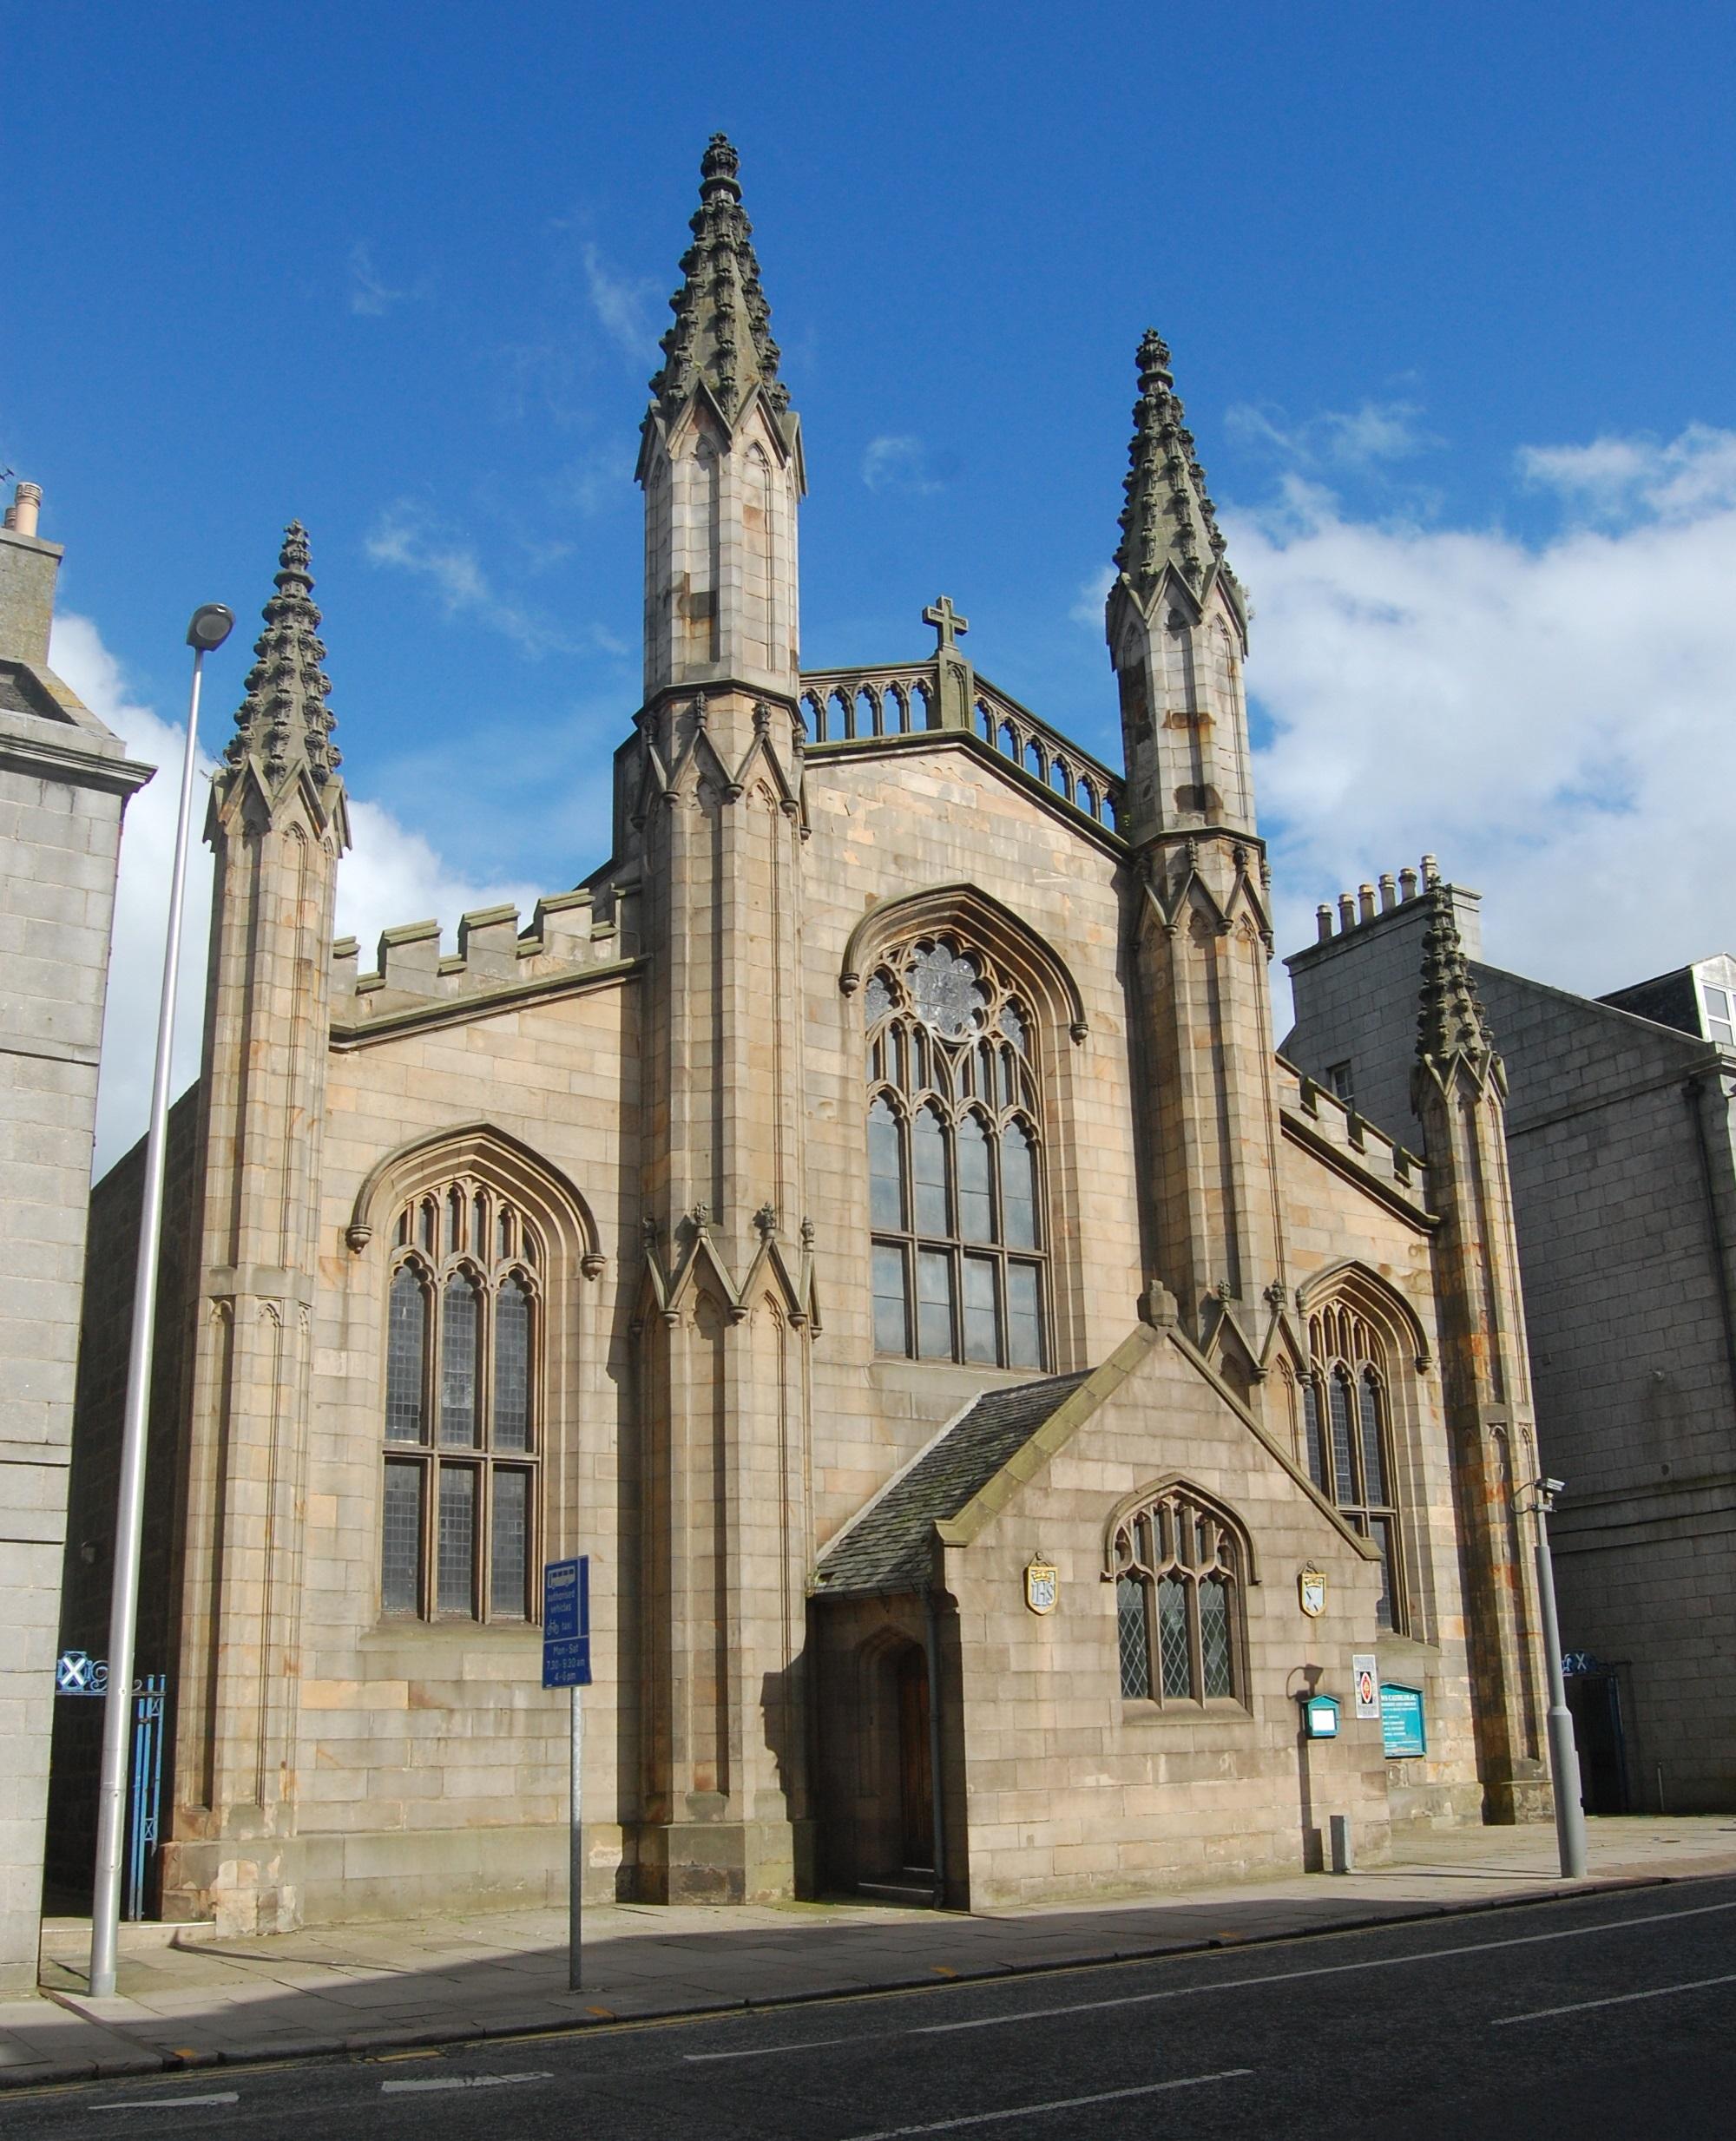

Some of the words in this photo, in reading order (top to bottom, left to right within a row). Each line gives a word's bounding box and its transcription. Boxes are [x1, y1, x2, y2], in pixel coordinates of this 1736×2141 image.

[547, 1590, 575, 1602] authorised
[550, 1603, 572, 1613] vehicles
[562, 1621, 572, 1630] taxi
